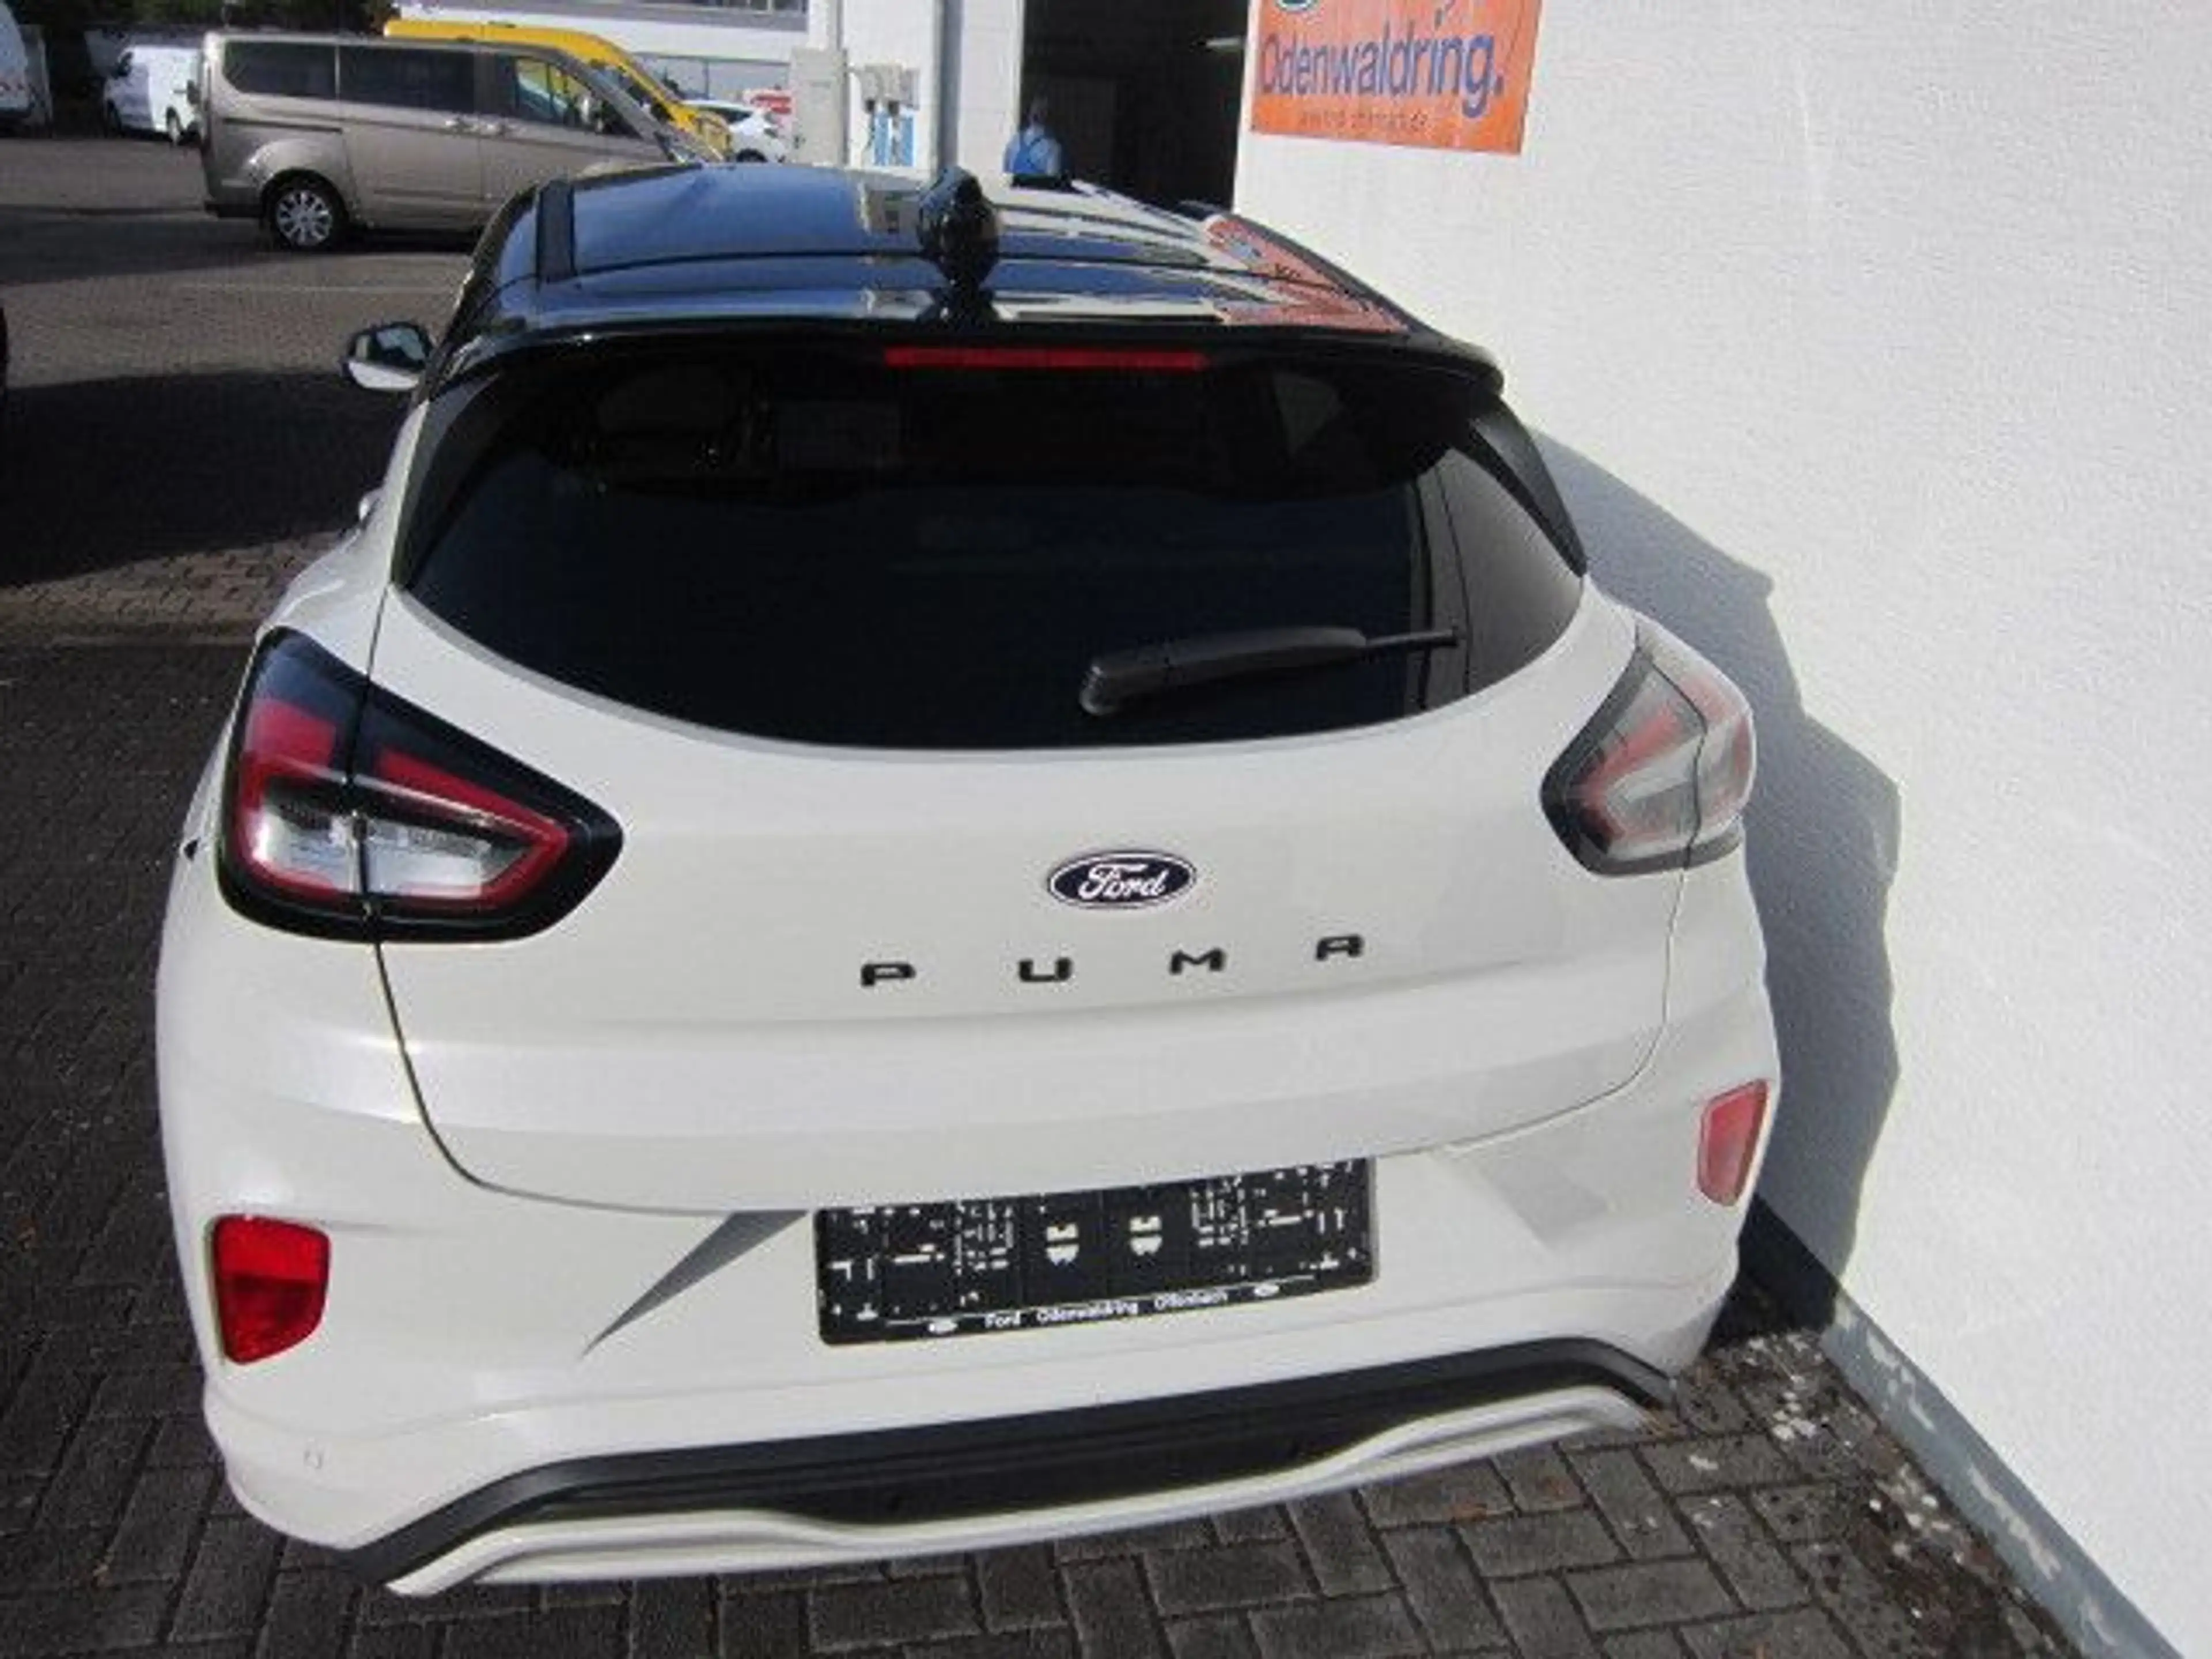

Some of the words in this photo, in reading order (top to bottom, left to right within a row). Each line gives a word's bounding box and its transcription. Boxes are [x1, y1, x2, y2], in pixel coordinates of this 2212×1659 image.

[1259, 8, 1504, 118] Odenwaldring.
[1077, 862, 1169, 900] Ford
[861, 934, 1364, 987] PUMA
[984, 1312, 1021, 1328] Ford
